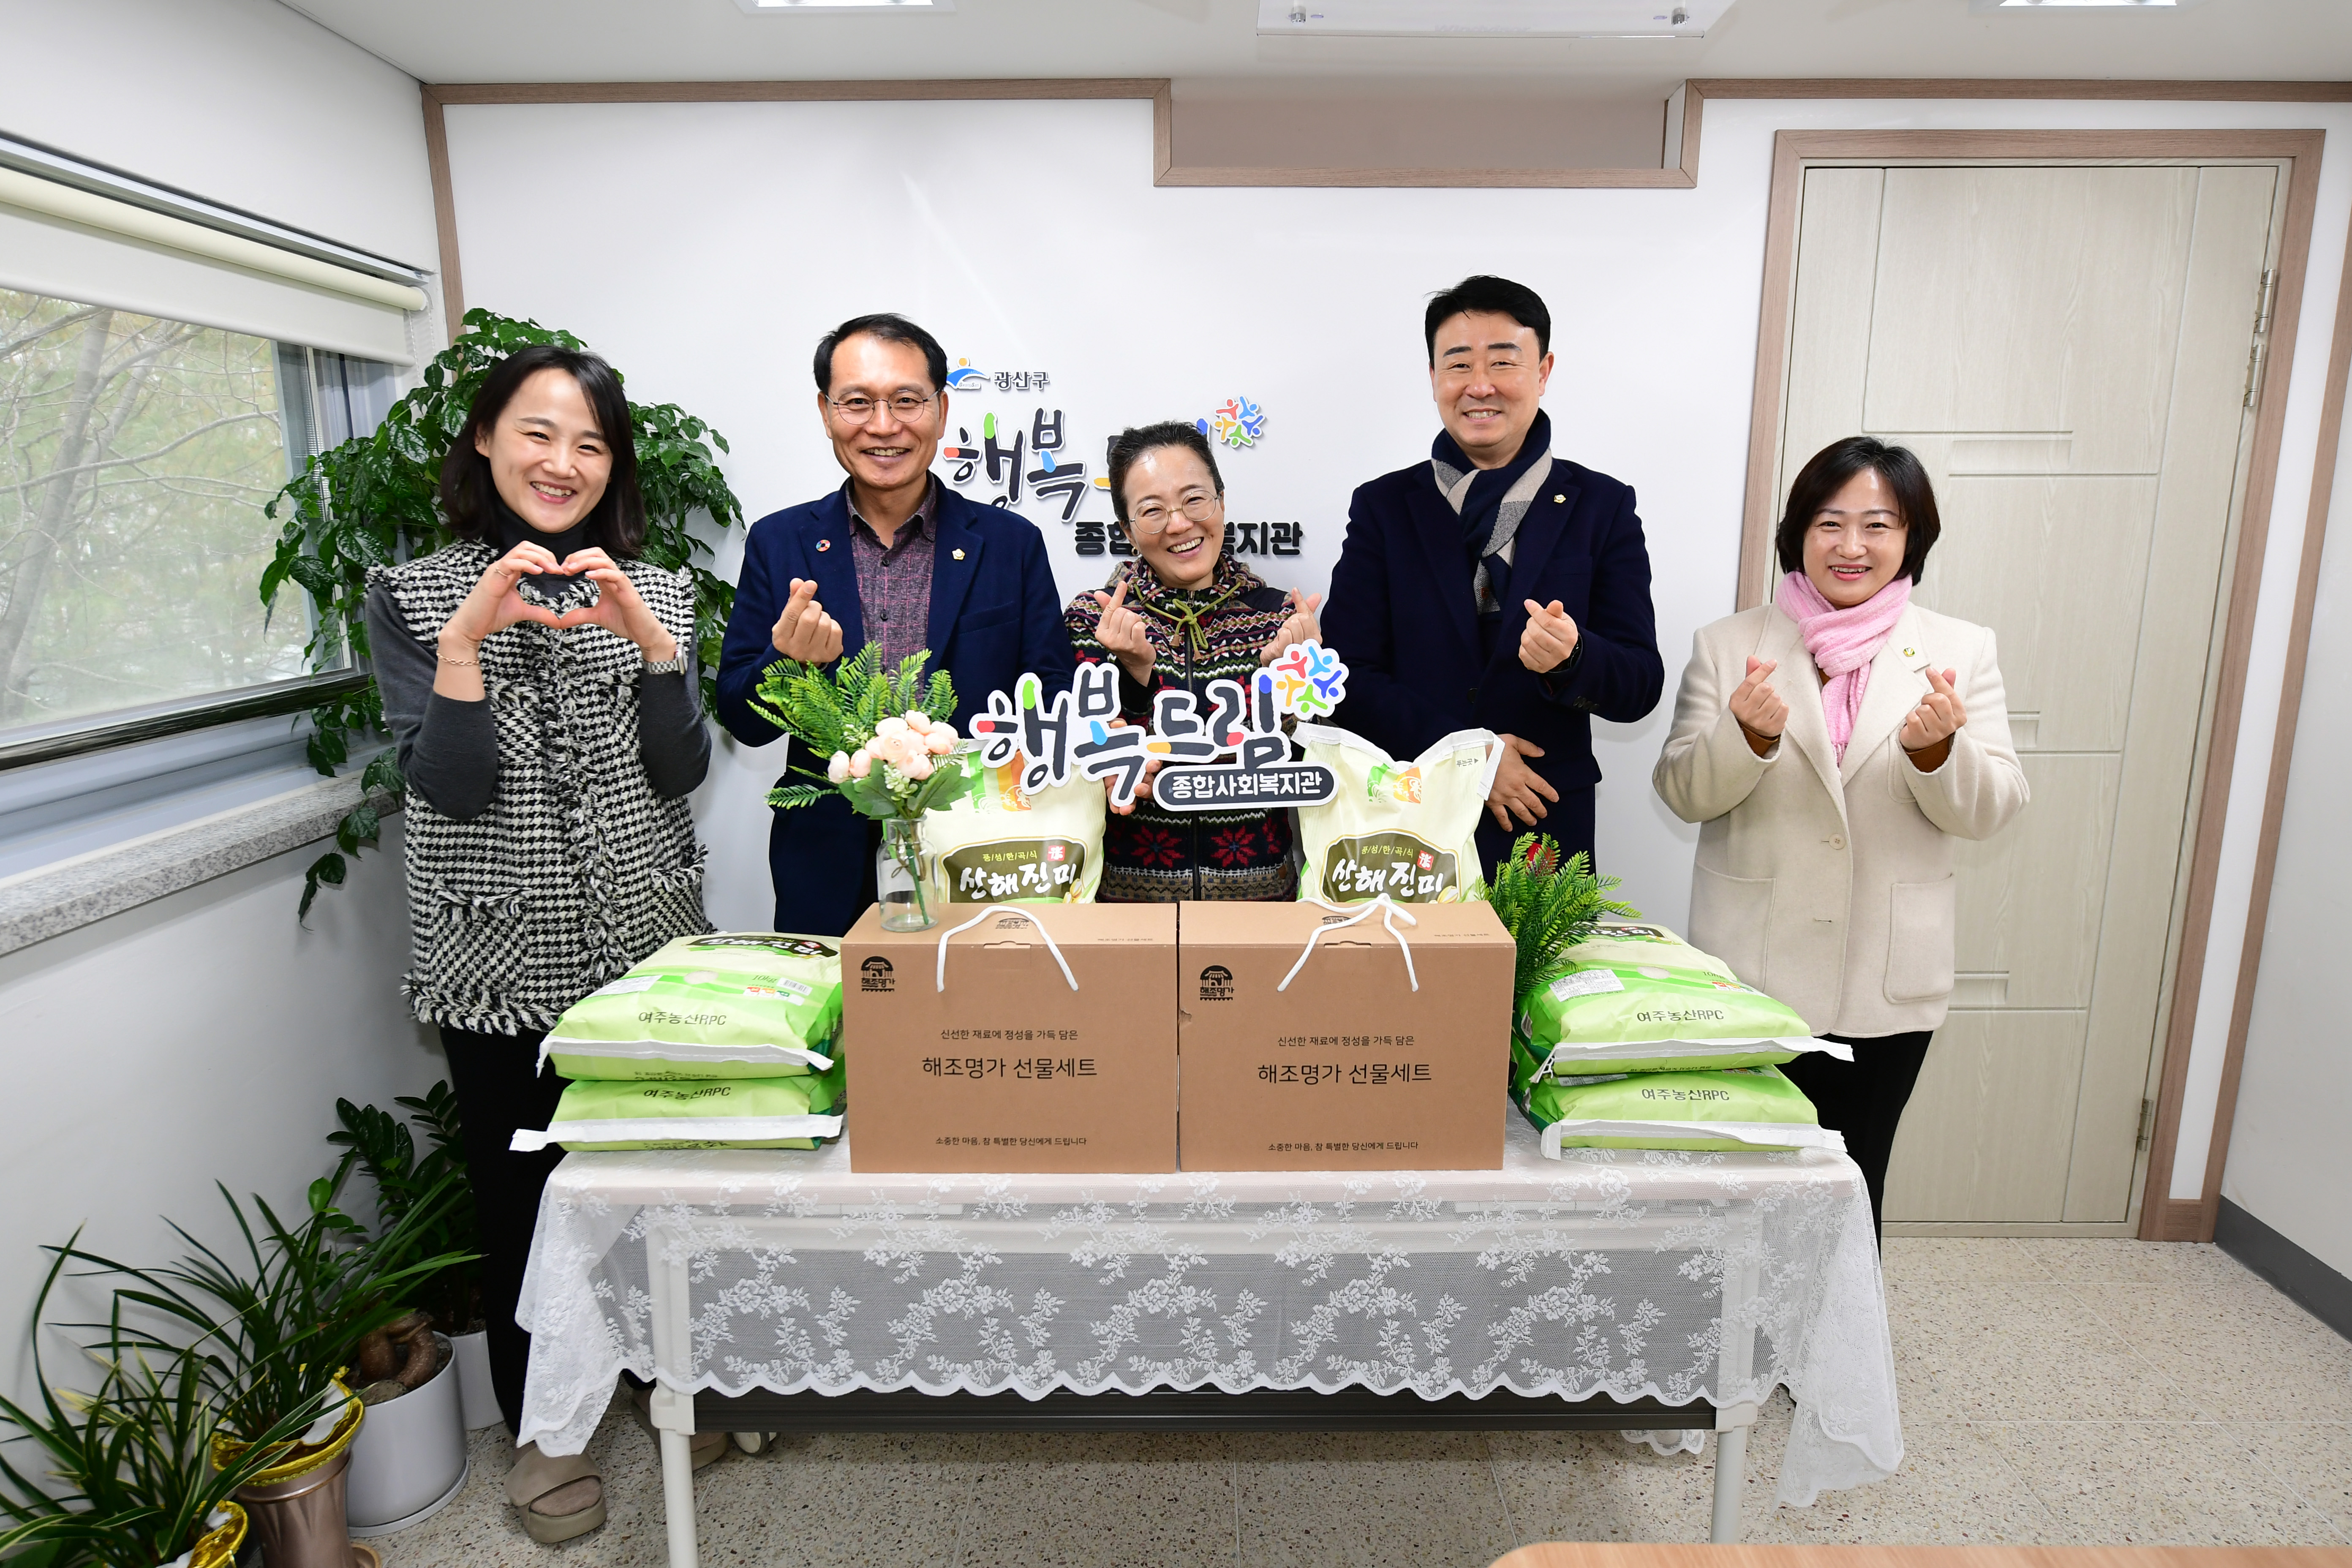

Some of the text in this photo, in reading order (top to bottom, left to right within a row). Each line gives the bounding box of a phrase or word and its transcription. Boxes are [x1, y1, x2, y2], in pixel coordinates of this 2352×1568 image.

[994, 371, 1048, 388] 광산구
[977, 669, 1283, 800] 행복드림
[1456, 758, 1473, 768] 푸는곳
[1172, 771, 1323, 799] 종합사회복지관
[959, 861, 1077, 900] 산해진미
[1332, 858, 1444, 897] 산해진미
[752, 975, 777, 983] 10kg
[861, 977, 895, 988] 해조명가
[1200, 986, 1234, 996] 해조명가
[638, 1011, 727, 1026] 여주농산RPC
[1636, 1009, 1724, 1023] 여주농산RPC
[941, 1029, 1078, 1040] 신선한 재료에 정성을 가득 담은
[1277, 1035, 1415, 1047] 신선한 재료에 정성을 가득 담은
[922, 1057, 1098, 1080] 해조명가 선물세트
[1257, 1063, 1432, 1085] 해조명가 선물세트
[643, 1086, 732, 1100] 여주농산RPC
[1641, 1089, 1730, 1101] 여주농산RPC
[936, 1137, 1087, 1146] 소중한 마음, 참 특별한 당신에게 드립니다
[1268, 1141, 1419, 1152] 소중한 마음, 참 특별한 당신에게 드립니다
